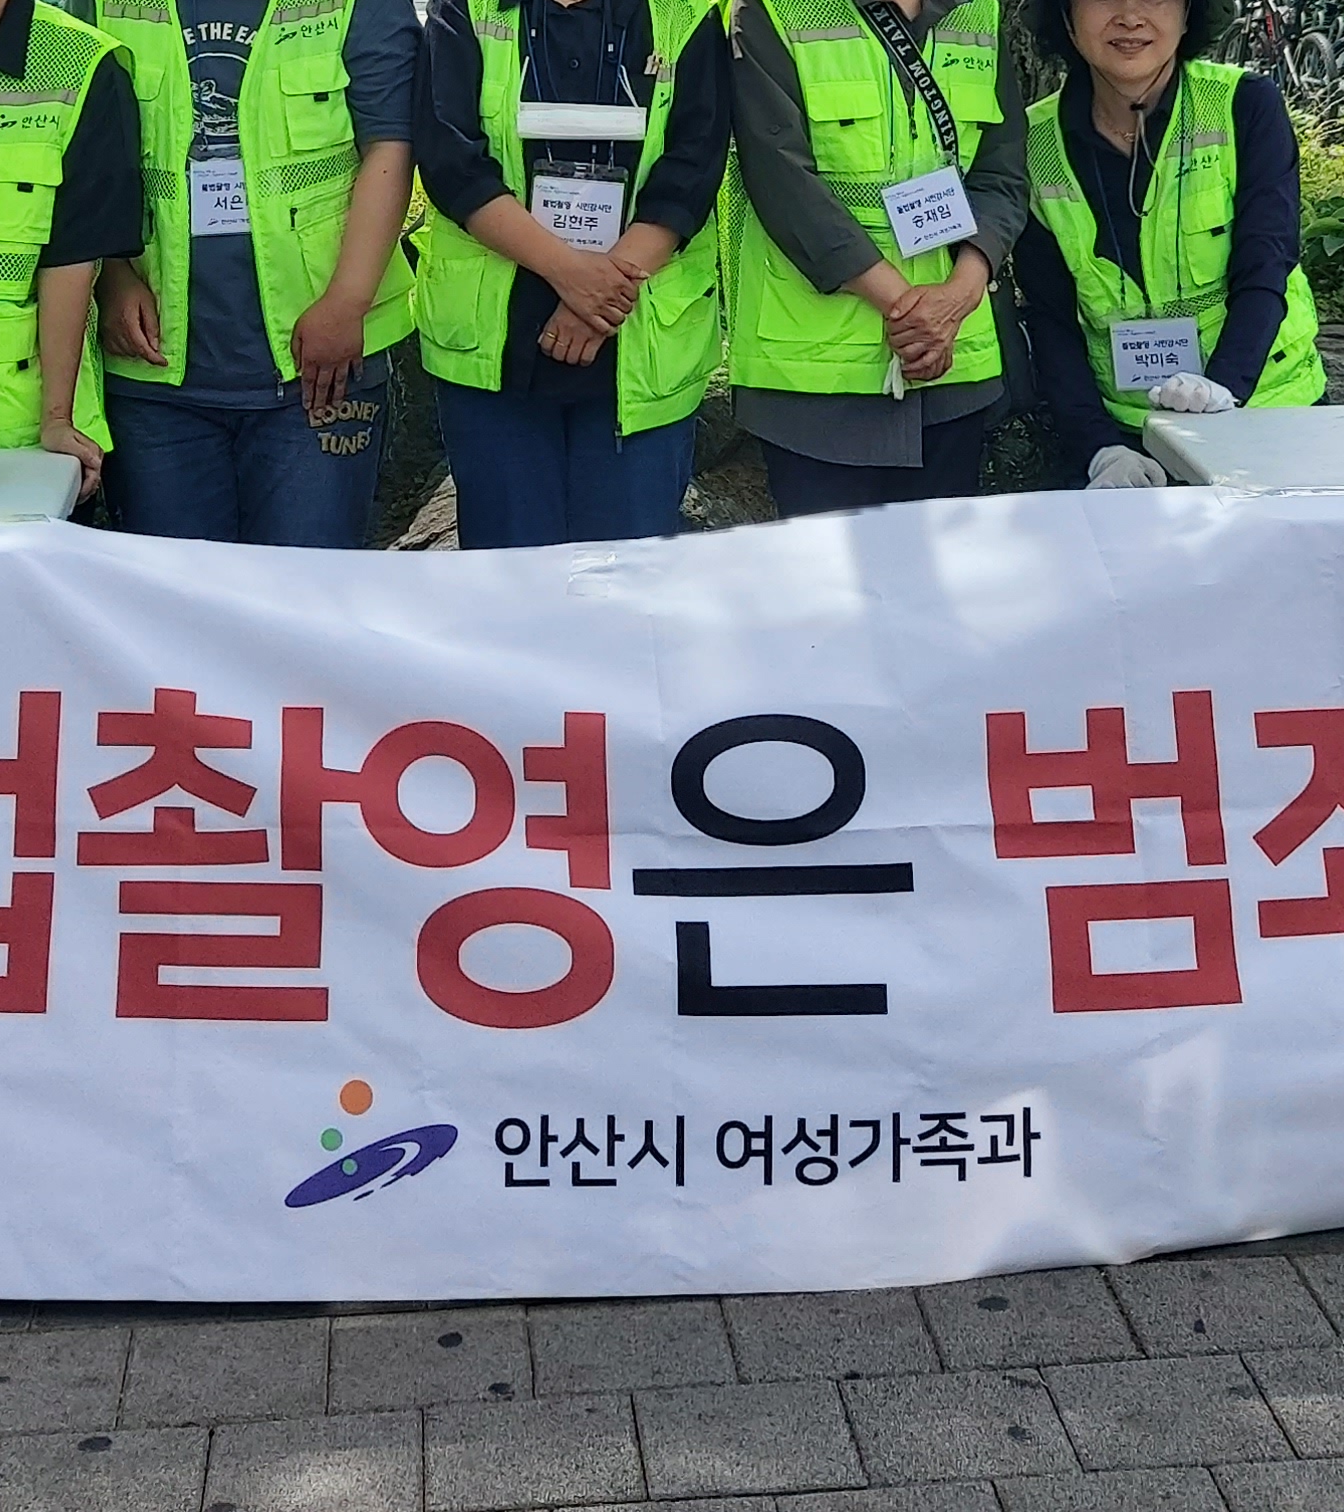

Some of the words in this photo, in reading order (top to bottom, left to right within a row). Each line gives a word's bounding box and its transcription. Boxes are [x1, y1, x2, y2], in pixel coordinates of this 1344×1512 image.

[197, 22, 234, 41] THE
[300, 17, 339, 38] 안산시
[963, 57, 994, 71] 안산시
[22, 114, 60, 130] 안산시
[912, 204, 952, 229] 송재임
[1135, 352, 1179, 368] 박미숙
[308, 400, 381, 428] LOONEY
[493, 1113, 686, 1188] 안산시
[715, 1107, 1042, 1186] 여성가족과
